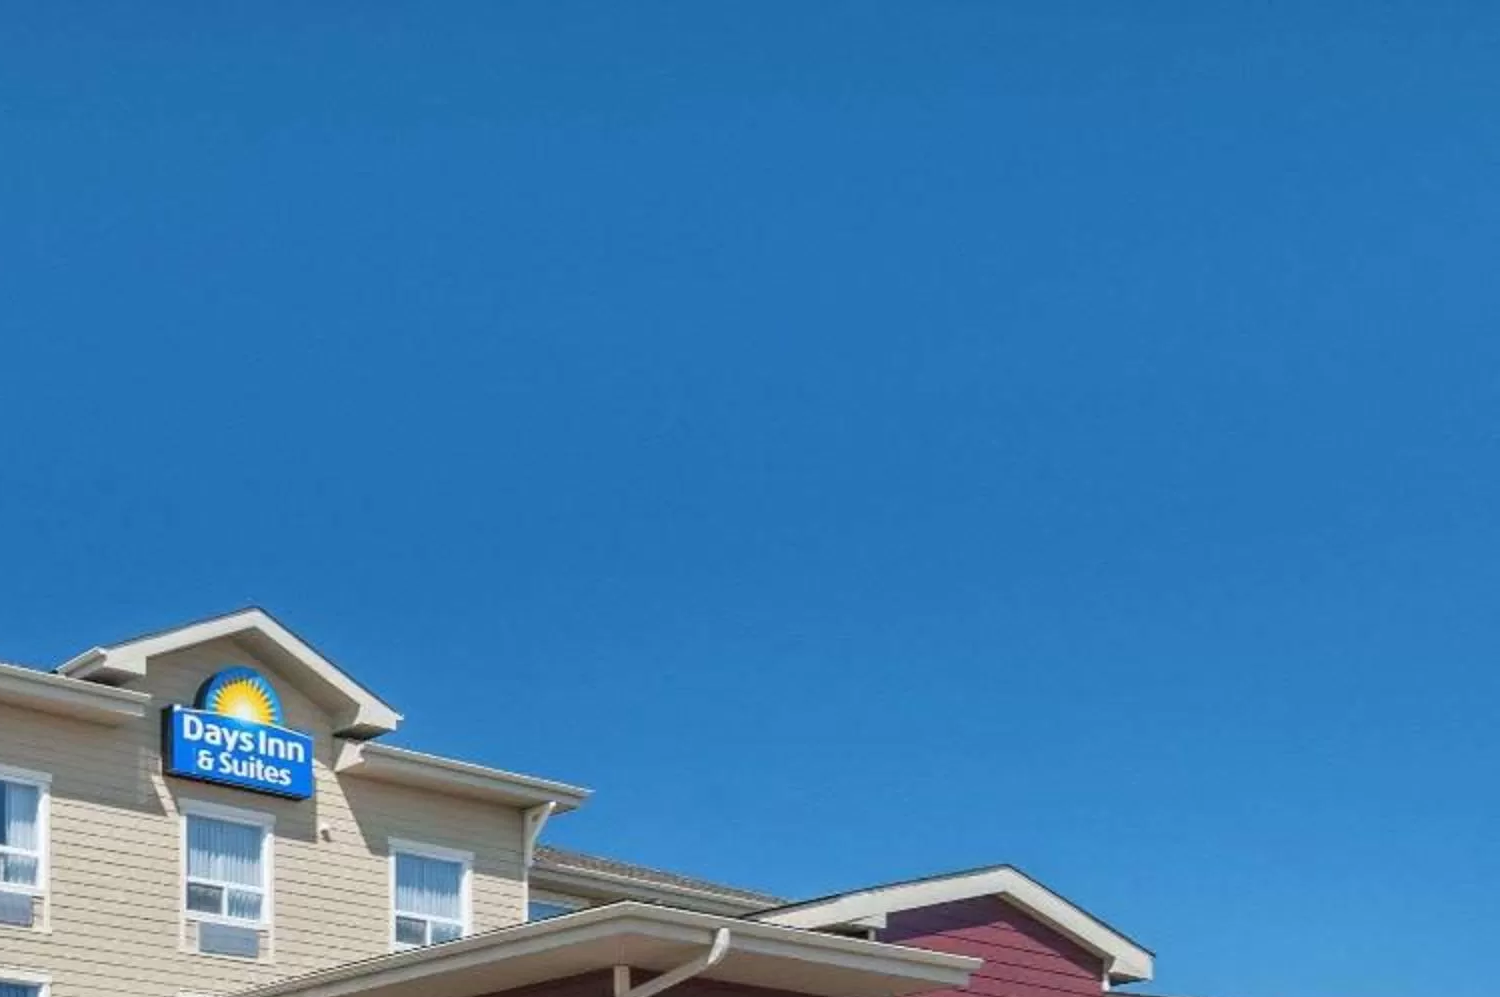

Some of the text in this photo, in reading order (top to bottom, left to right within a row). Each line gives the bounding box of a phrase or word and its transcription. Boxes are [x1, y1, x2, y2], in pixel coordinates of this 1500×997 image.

[183, 714, 305, 763] Days Inn
[197, 750, 292, 786] & Suites
